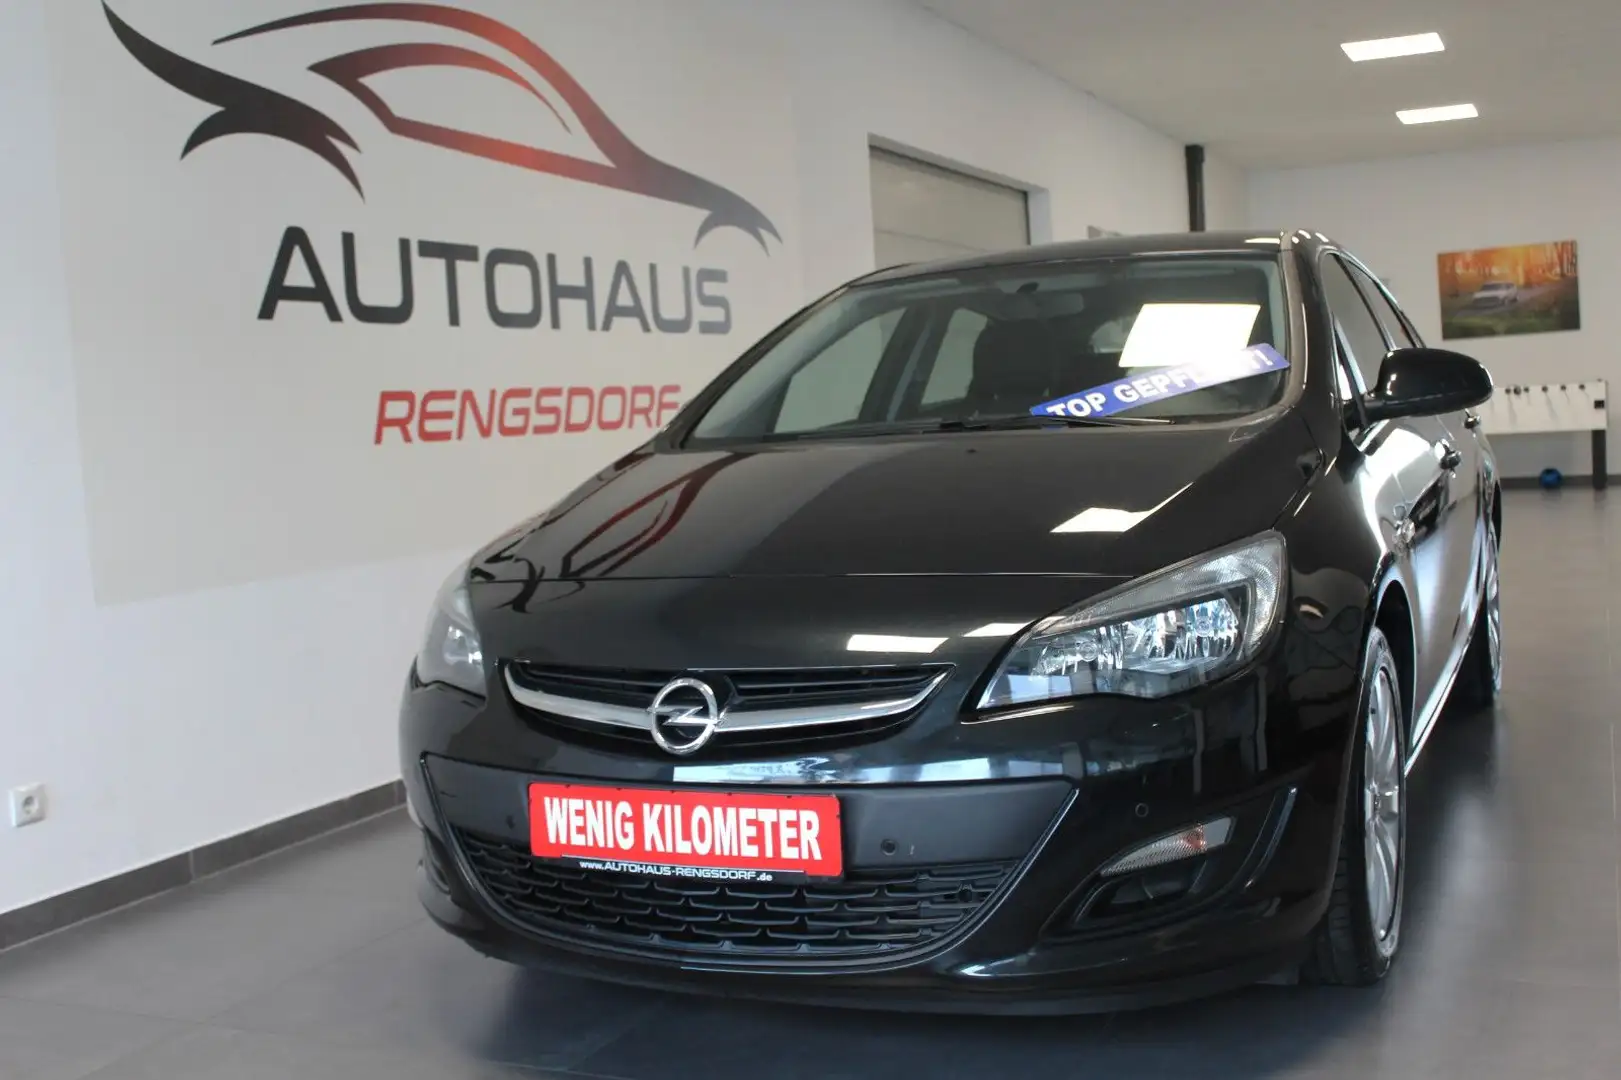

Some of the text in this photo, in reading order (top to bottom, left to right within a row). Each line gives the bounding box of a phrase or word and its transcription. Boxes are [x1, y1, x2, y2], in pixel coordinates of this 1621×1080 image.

[257, 225, 732, 335] AUTOHAUS
[374, 384, 681, 445] RENGSDORF
[1046, 392, 1106, 417] TOP
[544, 796, 822, 861] WENIG KILOMETER
[579, 861, 773, 882] www.AUTOHAUS-RENGSDORF.de
